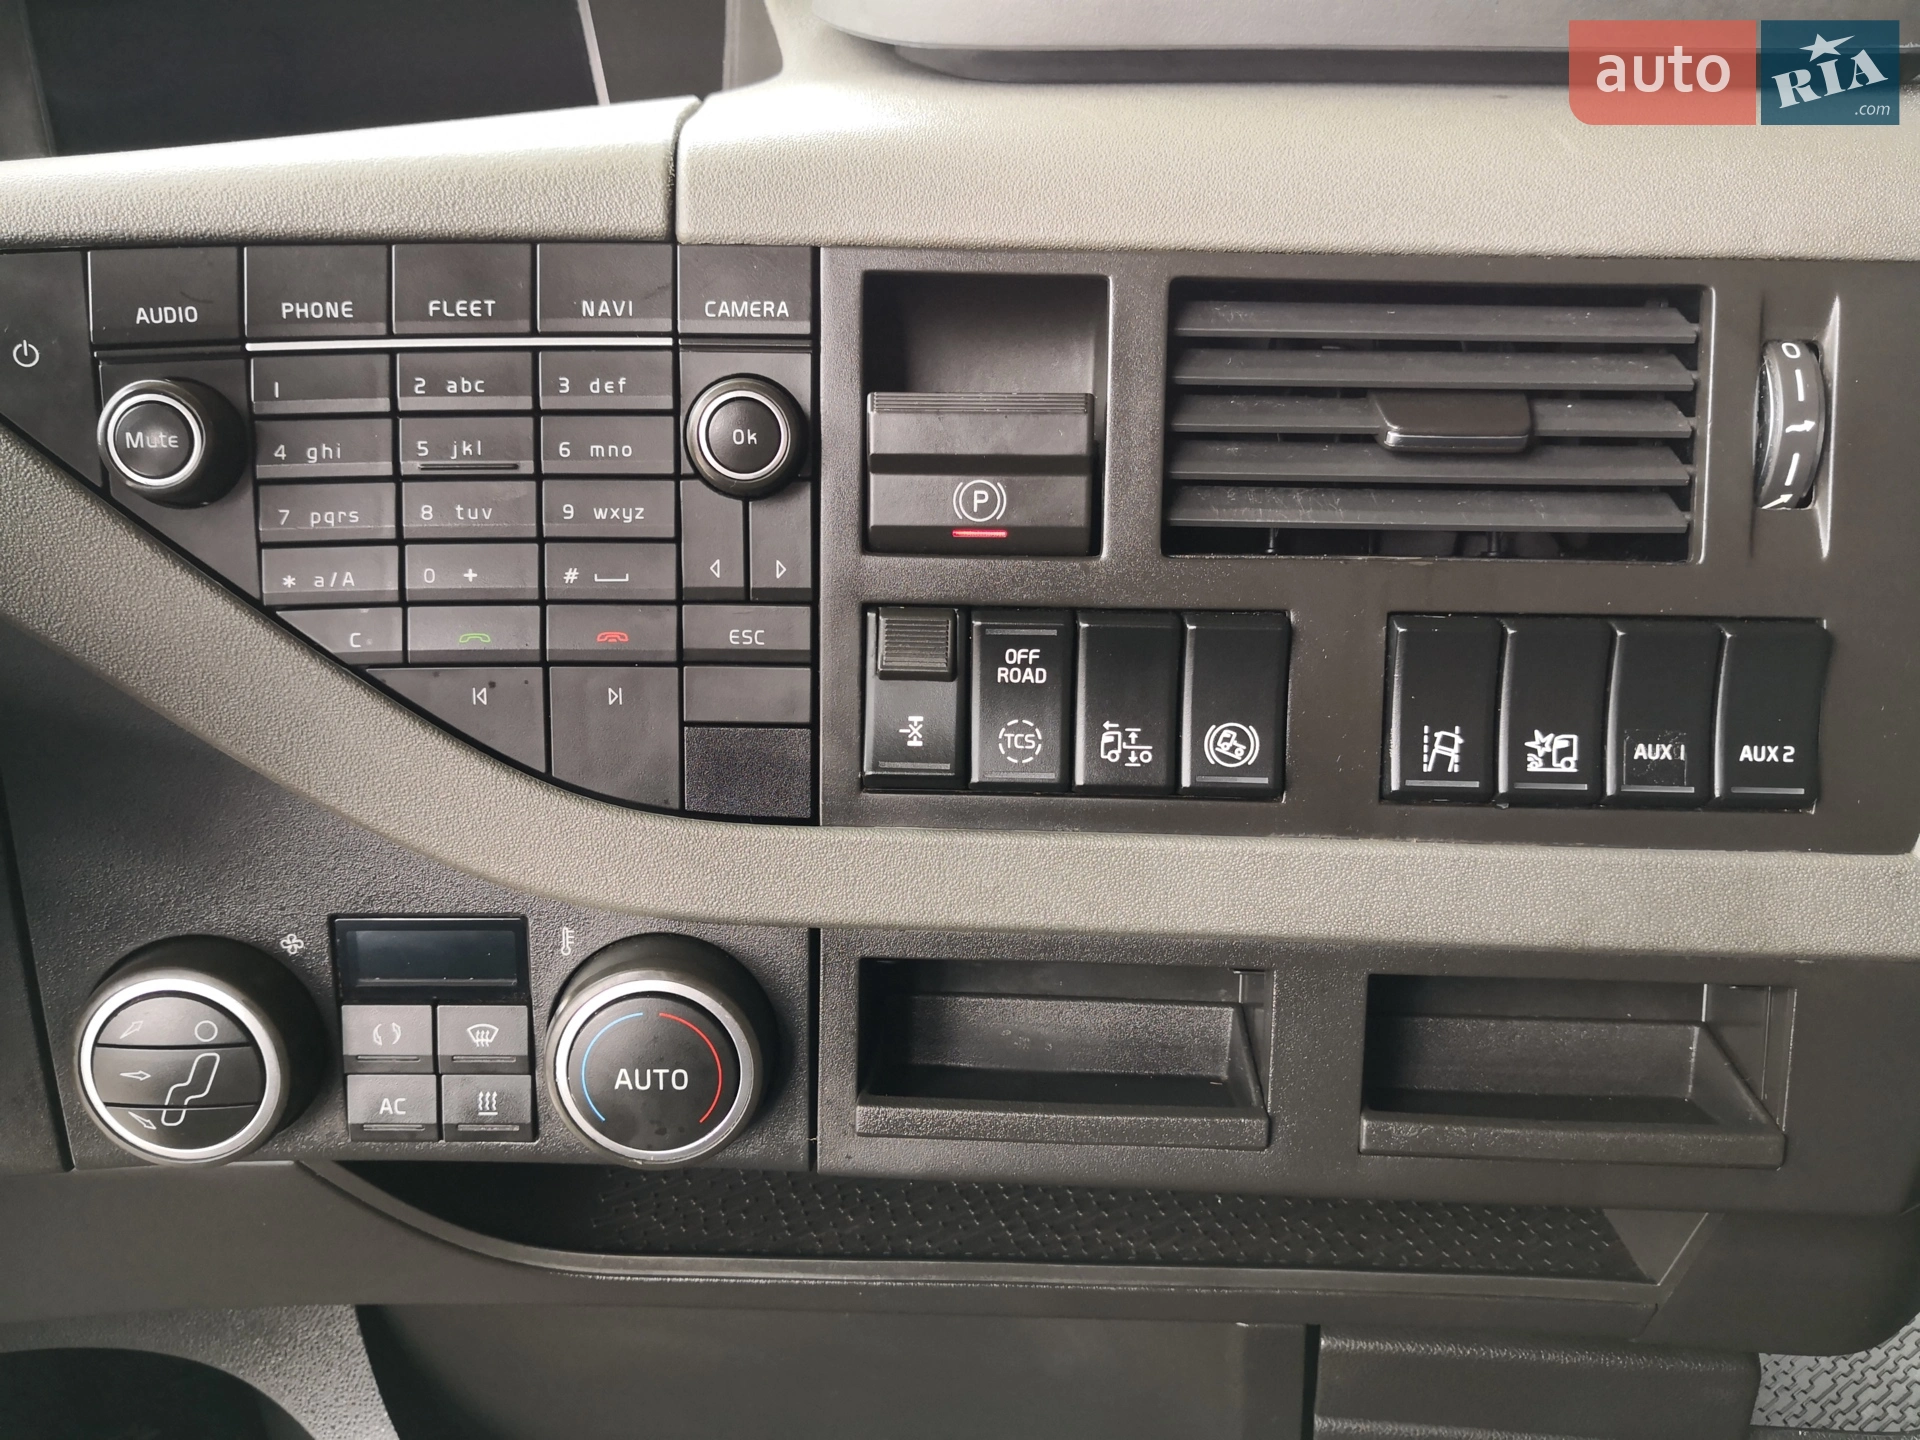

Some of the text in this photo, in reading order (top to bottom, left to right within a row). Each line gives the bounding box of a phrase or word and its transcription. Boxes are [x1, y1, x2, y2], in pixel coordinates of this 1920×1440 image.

[135, 305, 198, 325] AUDIO
[281, 300, 354, 319] PHONE
[428, 299, 496, 317] FLEET
[582, 300, 633, 317] NAVI
[704, 300, 789, 318] CAMERA
[414, 376, 485, 394] 2 abc
[558, 377, 627, 394] 3 def
[125, 430, 179, 449] Mute
[732, 428, 758, 445] Ok
[273, 443, 341, 464] 4 ghi
[417, 440, 481, 460] 5 jkl
[558, 441, 633, 458] 6 mno
[973, 490, 989, 512] P
[278, 509, 360, 527] 7 pqrs
[420, 504, 493, 521] 8 tuv
[562, 503, 645, 524] 9 wxyz
[314, 571, 355, 588] a/A
[423, 567, 436, 584] 0
[563, 567, 580, 584] #
[349, 632, 362, 648] C
[729, 629, 765, 646] ESC
[1004, 648, 1041, 665] OFF
[997, 666, 1047, 684] ROAD
[1003, 733, 1036, 749] TCS
[1633, 743, 1673, 761] AUX
[1739, 744, 1796, 763] AUX 2
[614, 1067, 689, 1091] AUTO
[379, 1097, 406, 1115] AC
